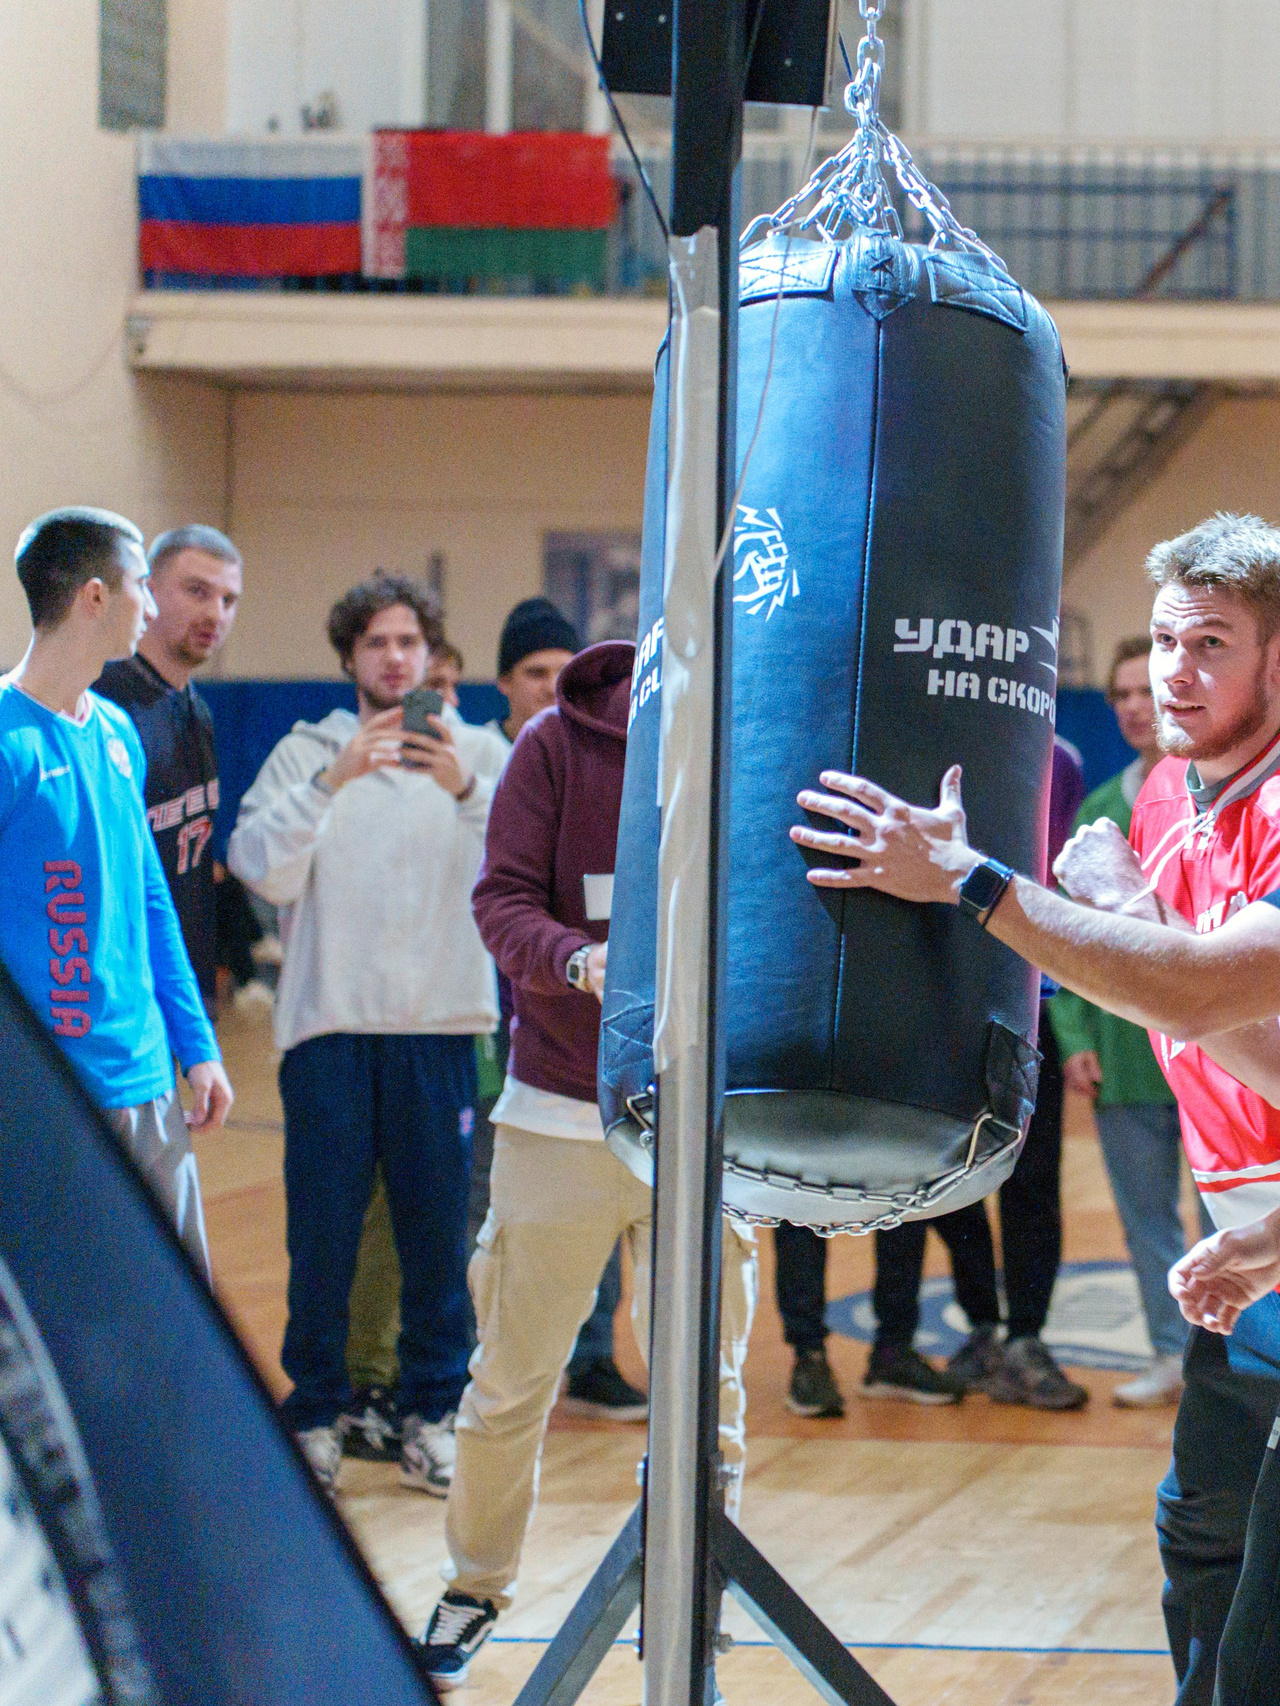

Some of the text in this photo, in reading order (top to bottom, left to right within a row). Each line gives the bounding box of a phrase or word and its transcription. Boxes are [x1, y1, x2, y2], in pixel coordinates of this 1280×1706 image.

[893, 618, 1030, 662] УДАР
[927, 669, 981, 700] НА
[177, 815, 213, 876] 17
[44, 860, 92, 1038] RUSSIA
